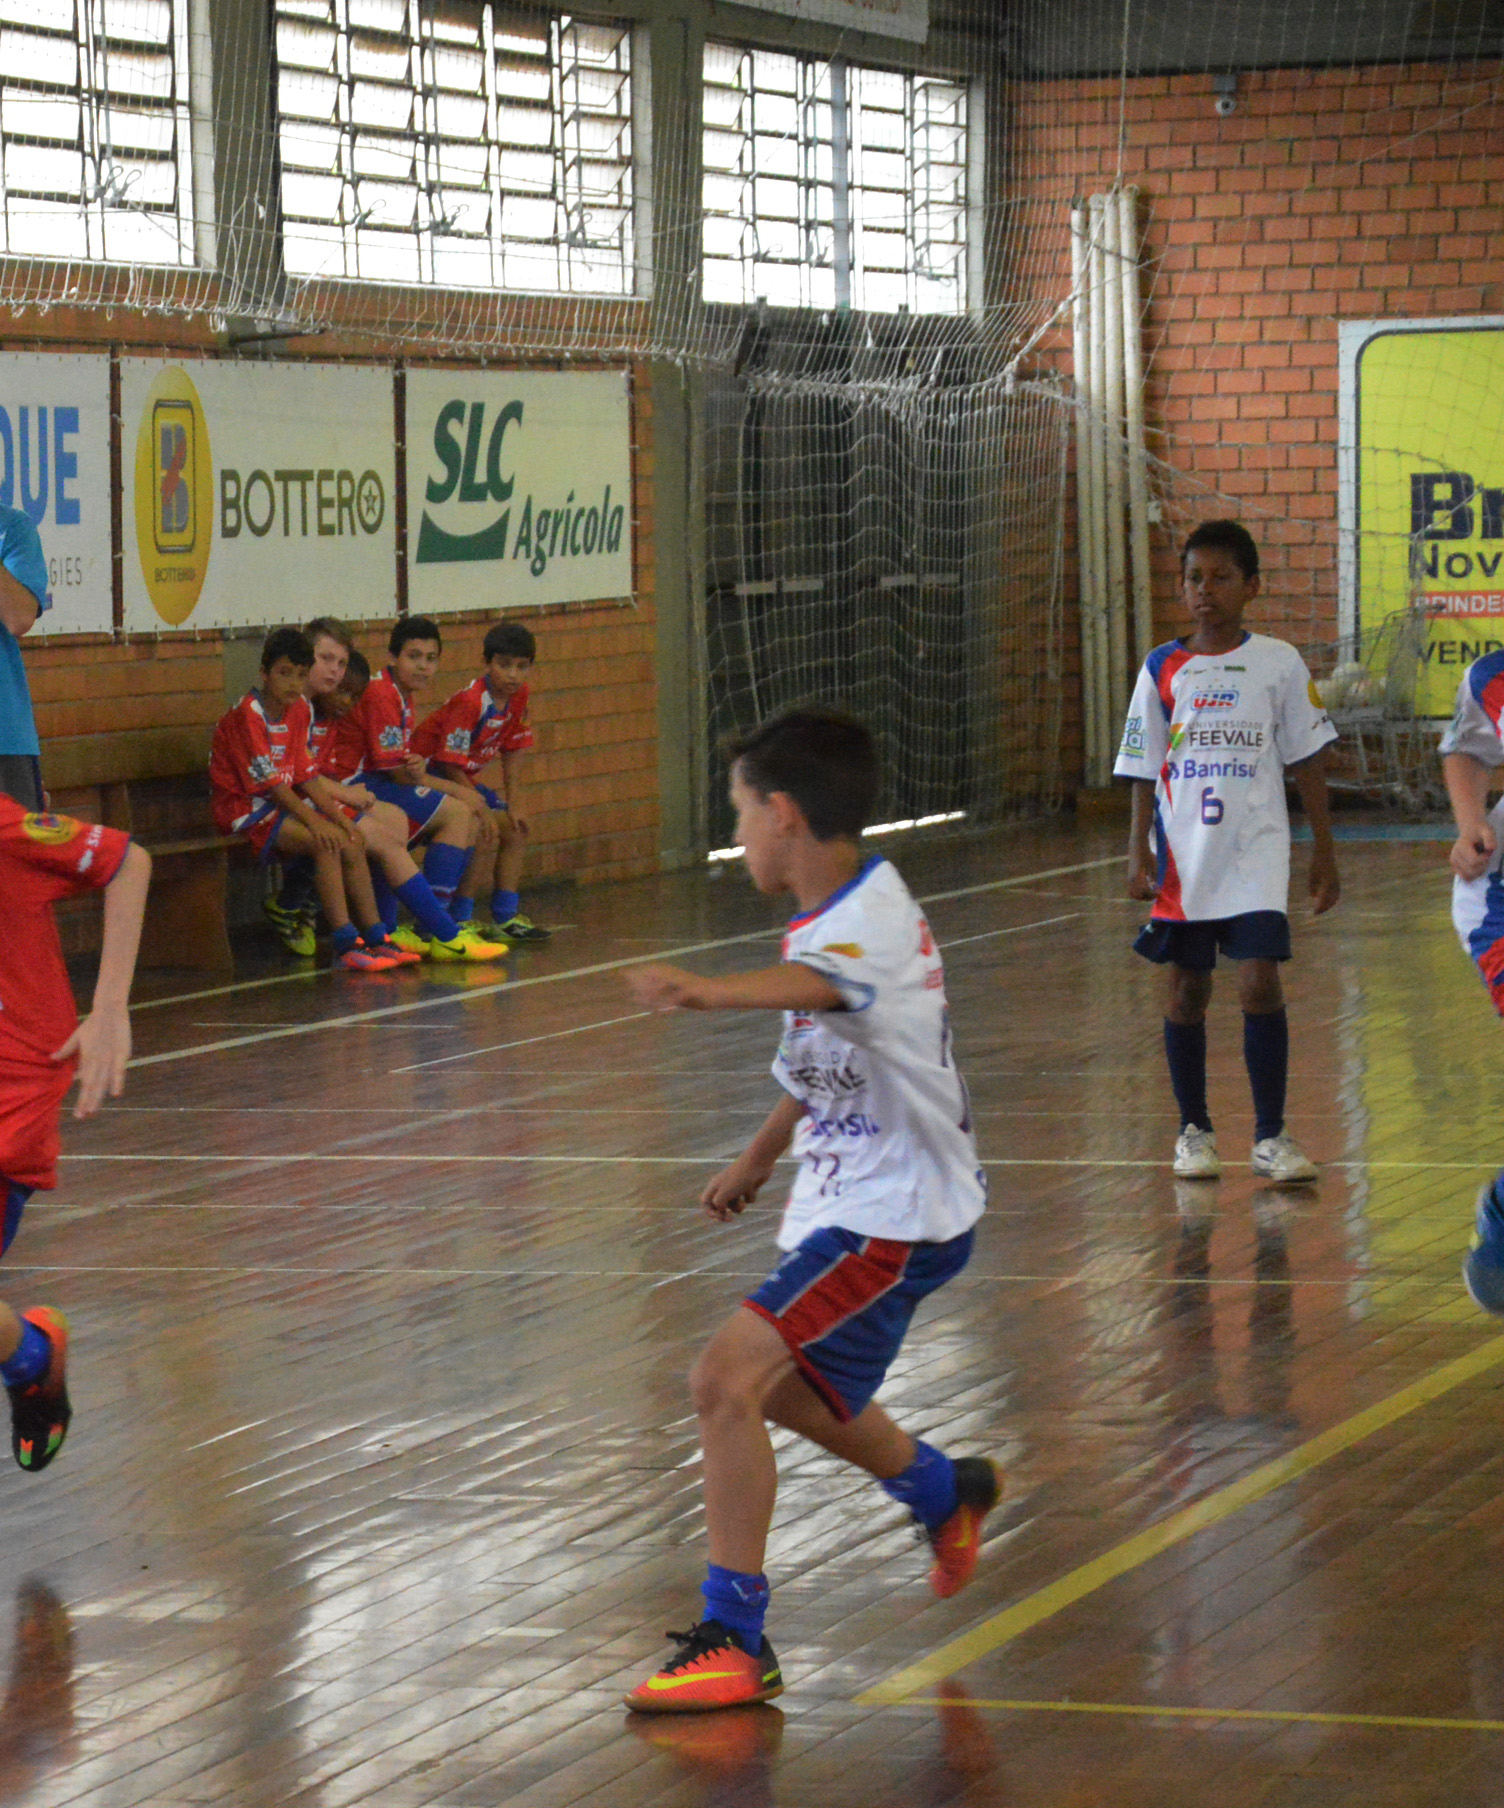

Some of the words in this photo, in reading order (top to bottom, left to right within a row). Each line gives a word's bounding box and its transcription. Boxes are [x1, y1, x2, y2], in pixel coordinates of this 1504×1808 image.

[425, 399, 524, 504] SLC
[220, 469, 385, 538] BOTTERO
[512, 484, 625, 577] Agrícola
[1189, 730, 1264, 747] FEEVALE
[1183, 757, 1259, 779] Banrisu
[1201, 786, 1225, 826] 6
